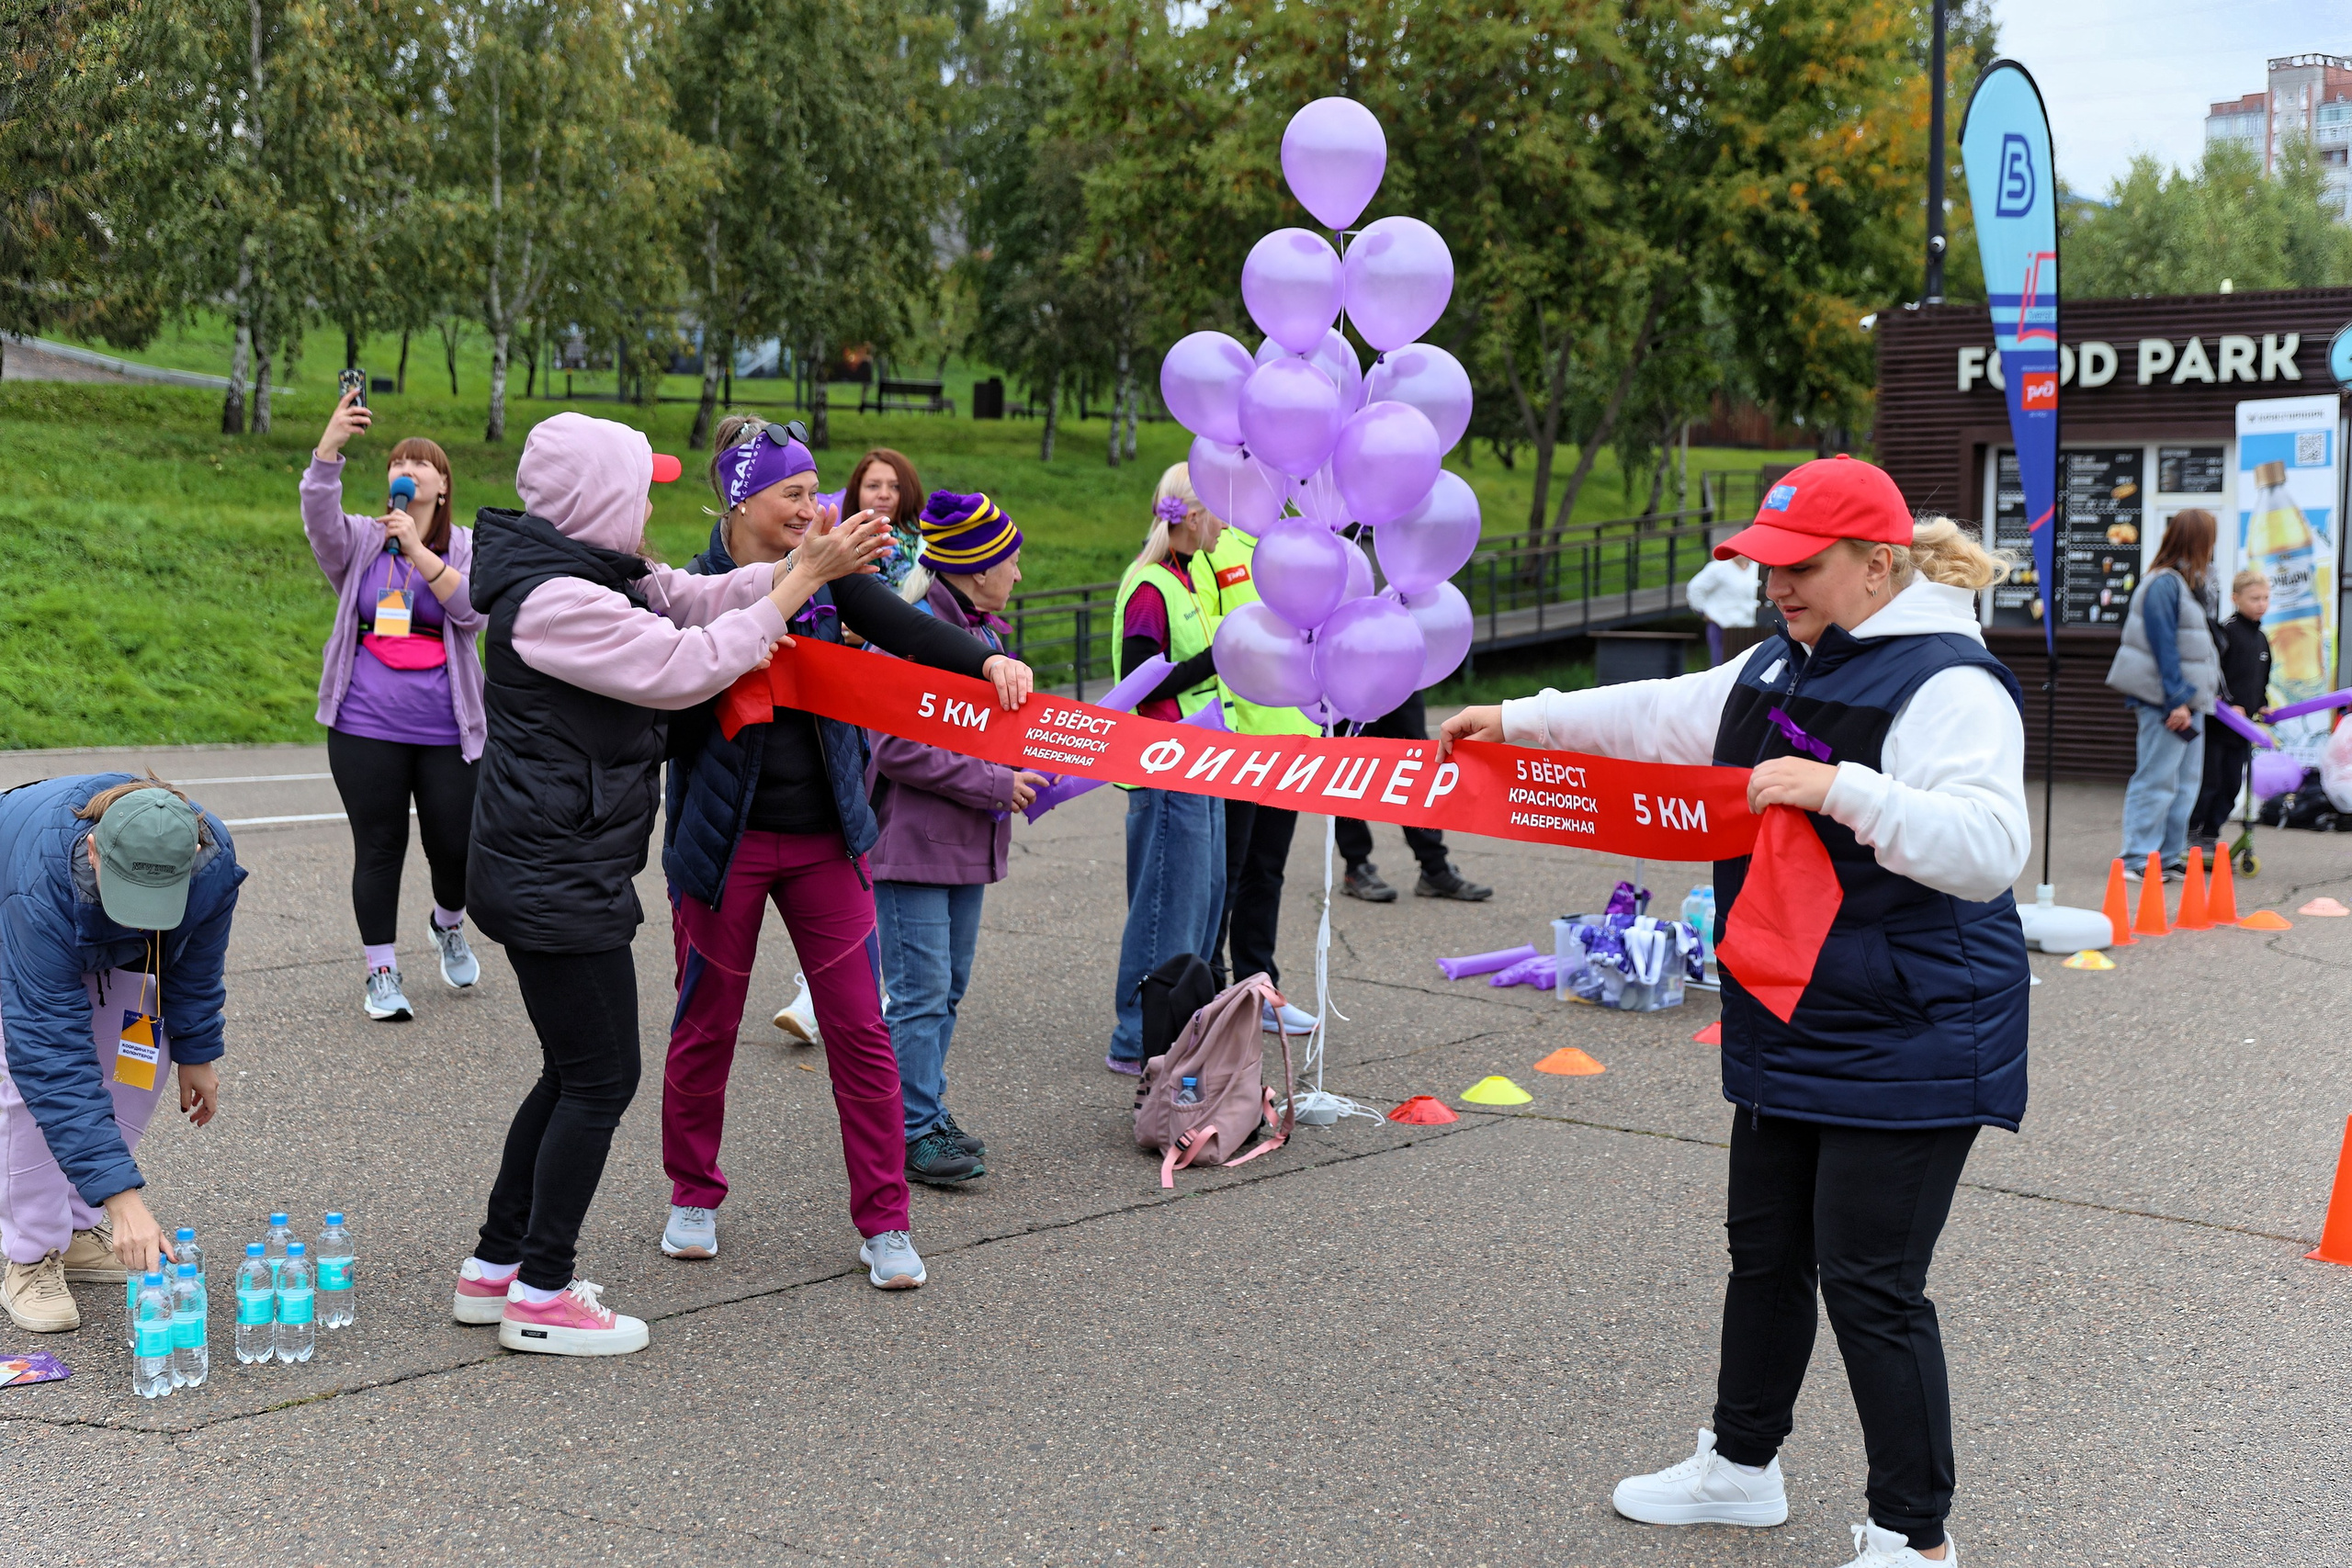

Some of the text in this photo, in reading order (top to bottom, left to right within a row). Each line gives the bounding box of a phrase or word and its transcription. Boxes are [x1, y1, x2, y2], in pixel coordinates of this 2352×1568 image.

[2137, 333, 2302, 386] PARK
[917, 692, 991, 732] 5 КМ
[1039, 707, 1117, 736] 5 ВЁРСТ
[1024, 728, 1111, 753] КРАСНОЯРСК
[1023, 745, 1095, 767] НАБЕРЕЖНАЯ
[1139, 738, 1461, 808] ФИНИШЁР
[1516, 757, 1587, 788] 5 ВЁРСТ
[1508, 787, 1599, 814] КРАСНОЯРСК
[1633, 793, 1709, 833] 5 КМ
[1510, 811, 1596, 835] НАБЕРЕЖНАЯ
[121, 1043, 156, 1055] КООРДИНАТОР
[122, 1049, 153, 1060] ВОЛОНТЕРОВ
